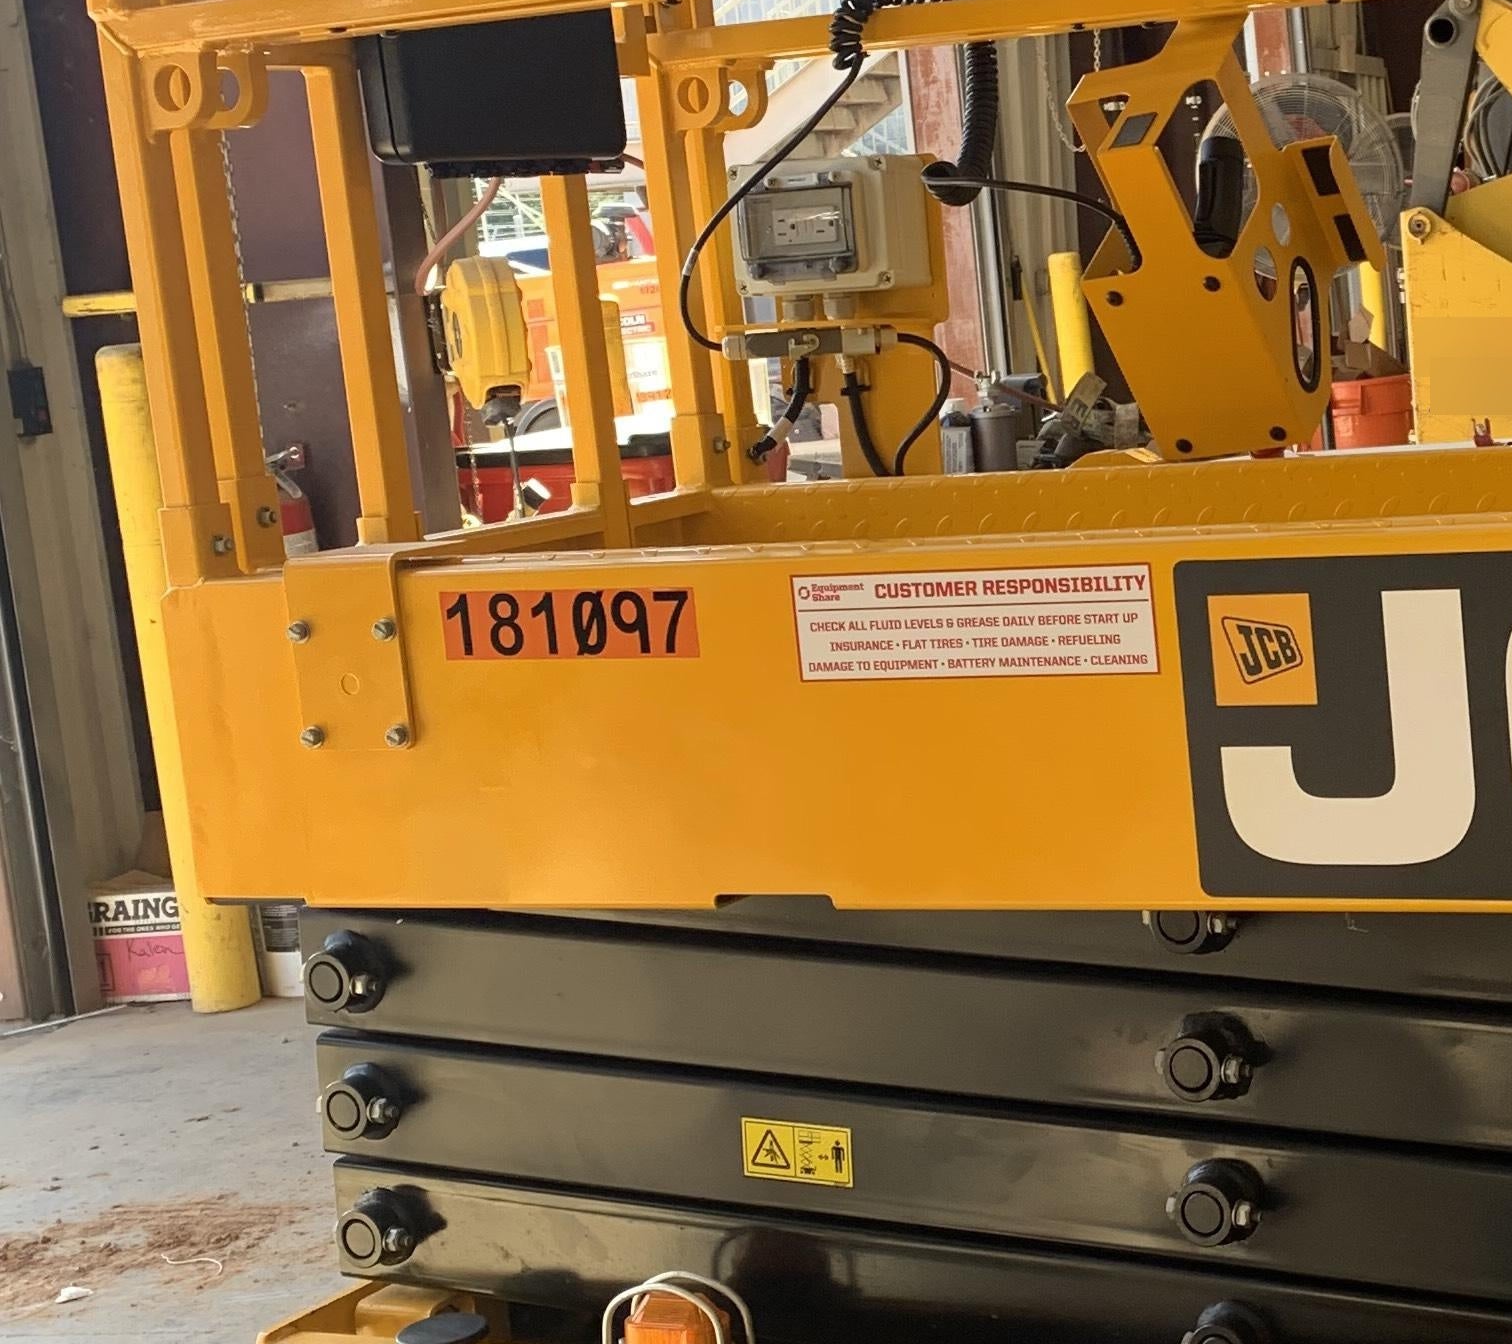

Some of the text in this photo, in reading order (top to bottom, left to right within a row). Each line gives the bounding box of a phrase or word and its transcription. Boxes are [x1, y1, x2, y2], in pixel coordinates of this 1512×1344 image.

[811, 582, 864, 594] Equipment
[874, 575, 1146, 599] CUSTOMER RESPONSIBILITY
[811, 593, 841, 602] Share
[810, 612, 1139, 633] CHECK ALL FLUID LEVELS & GREASE DAILY BEFORE START UP
[829, 634, 1121, 652] INSURANCE FLAT TIRES TIRE DAMAGE REFUELING
[1236, 623, 1297, 676] JCB
[809, 654, 1148, 673] DAMAGE TO EQUIPMENT BATTERY MAINTENANCE CLEANING
[88, 897, 179, 923] RAING
